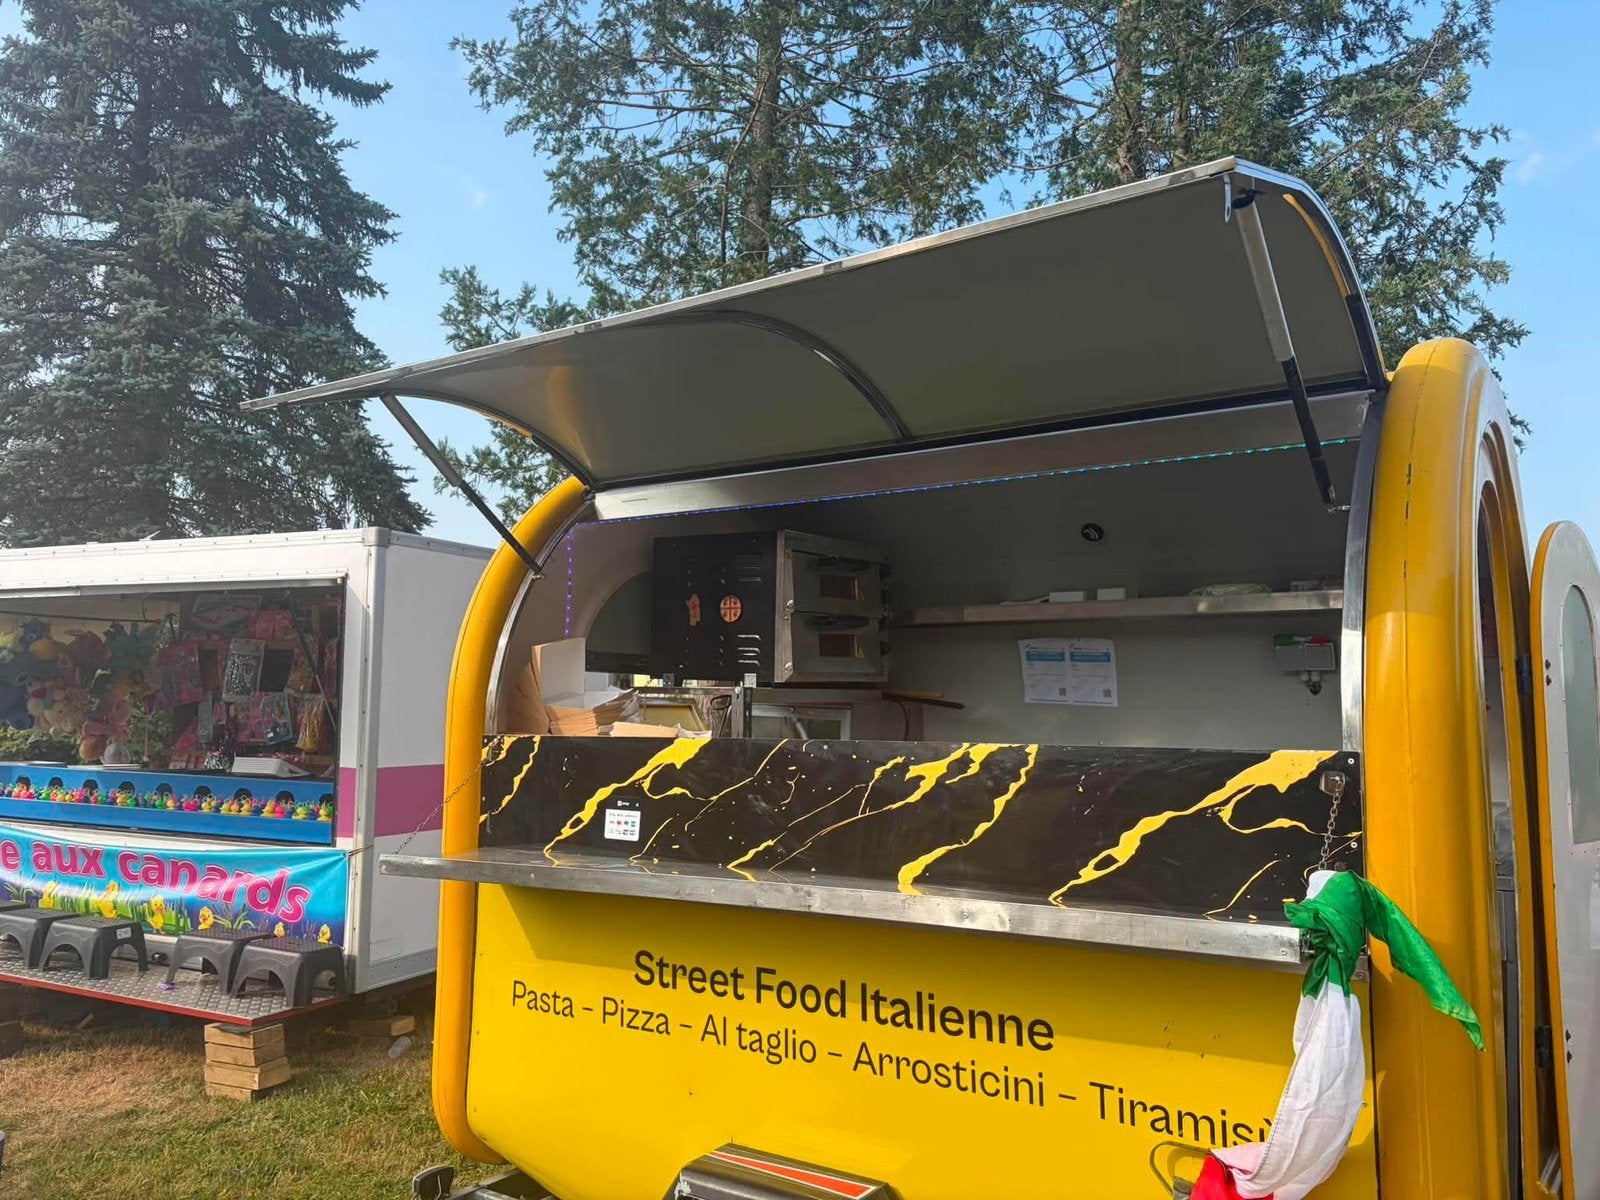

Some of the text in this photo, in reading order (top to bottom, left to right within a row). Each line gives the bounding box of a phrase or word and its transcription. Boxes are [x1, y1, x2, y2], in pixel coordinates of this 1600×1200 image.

[31, 840, 106, 877] aux
[117, 851, 311, 923] canards
[511, 979, 576, 1020] Pasta
[601, 996, 671, 1037] Pizza
[700, 1013, 729, 1048] Al
[735, 1022, 818, 1066] taglio
[852, 1041, 1047, 1109] Arrosticini
[633, 949, 1055, 1053] Street Food Italienne
